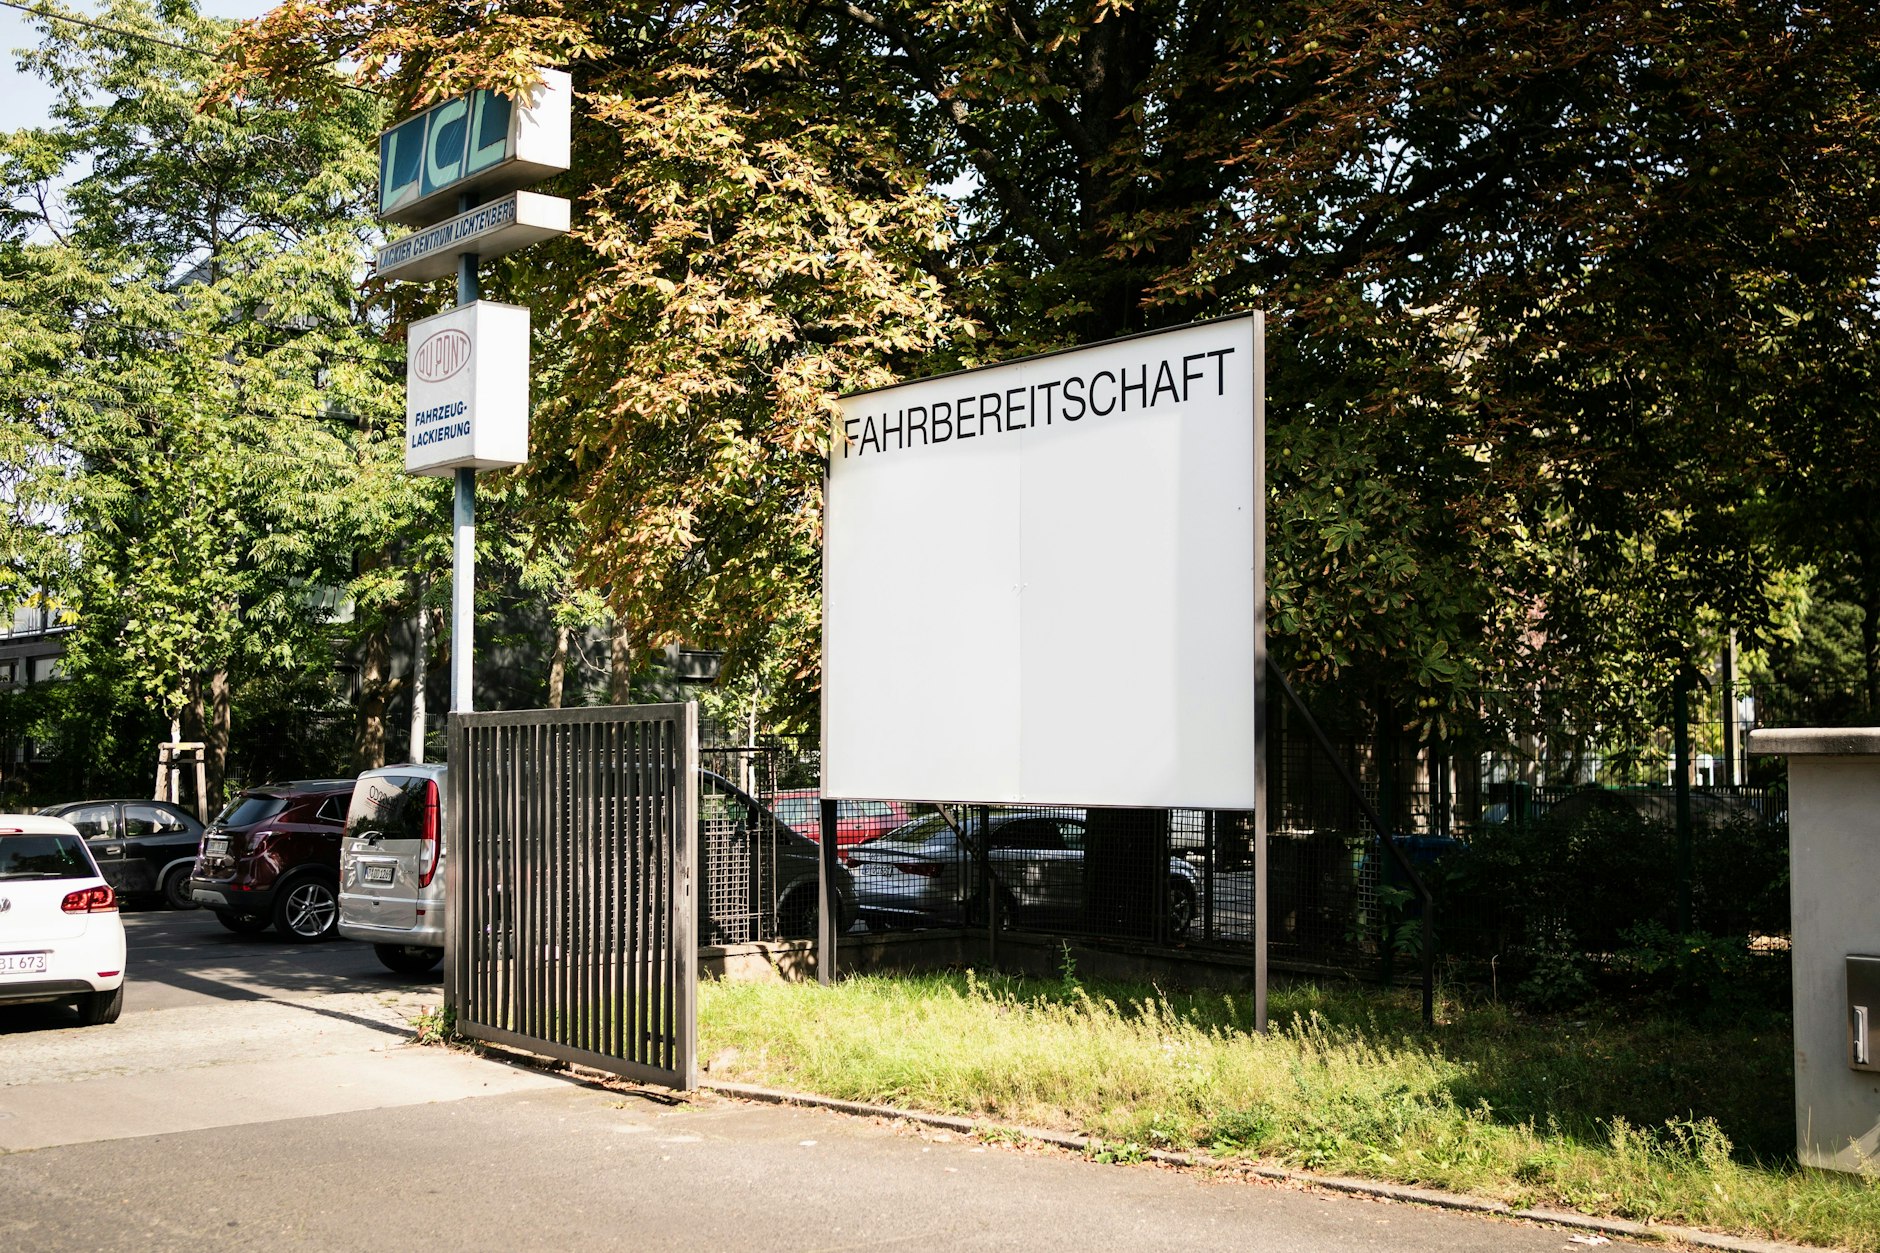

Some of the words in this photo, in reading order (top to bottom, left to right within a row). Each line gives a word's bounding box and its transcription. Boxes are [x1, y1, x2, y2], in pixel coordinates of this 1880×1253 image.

[379, 241, 412, 269] LACKIER
[413, 225, 454, 258] CENTRUM
[454, 200, 515, 240] LICHTENBERG
[415, 401, 468, 427] FAHRZEUG-
[844, 347, 1235, 459] FAHRBEREITSCHAFT
[411, 421, 471, 449] LACKIERUNG
[19, 956, 44, 969] 673
